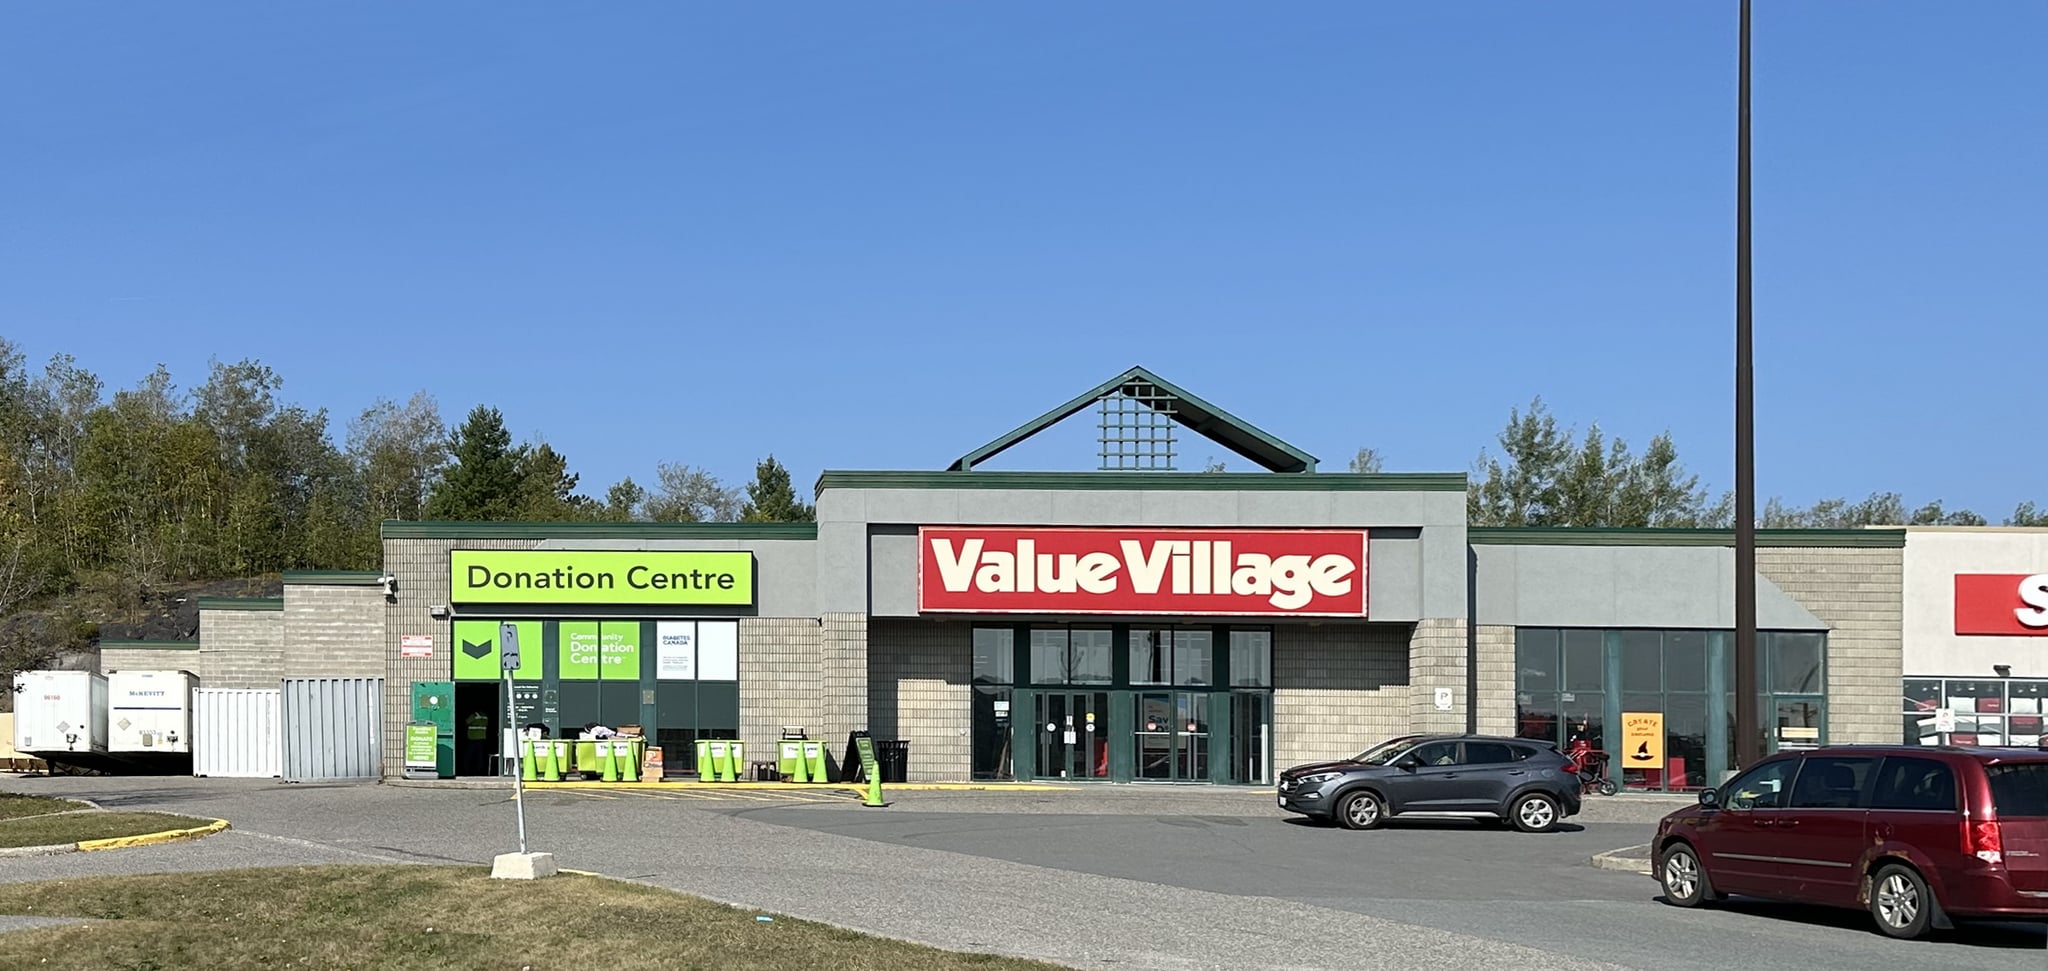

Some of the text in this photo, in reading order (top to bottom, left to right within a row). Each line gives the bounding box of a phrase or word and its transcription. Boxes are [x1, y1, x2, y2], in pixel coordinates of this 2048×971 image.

[467, 565, 735, 590] Donation Centre
[930, 538, 1357, 610] Value Village
[570, 641, 634, 652] Donation
[570, 653, 622, 664] Centre
